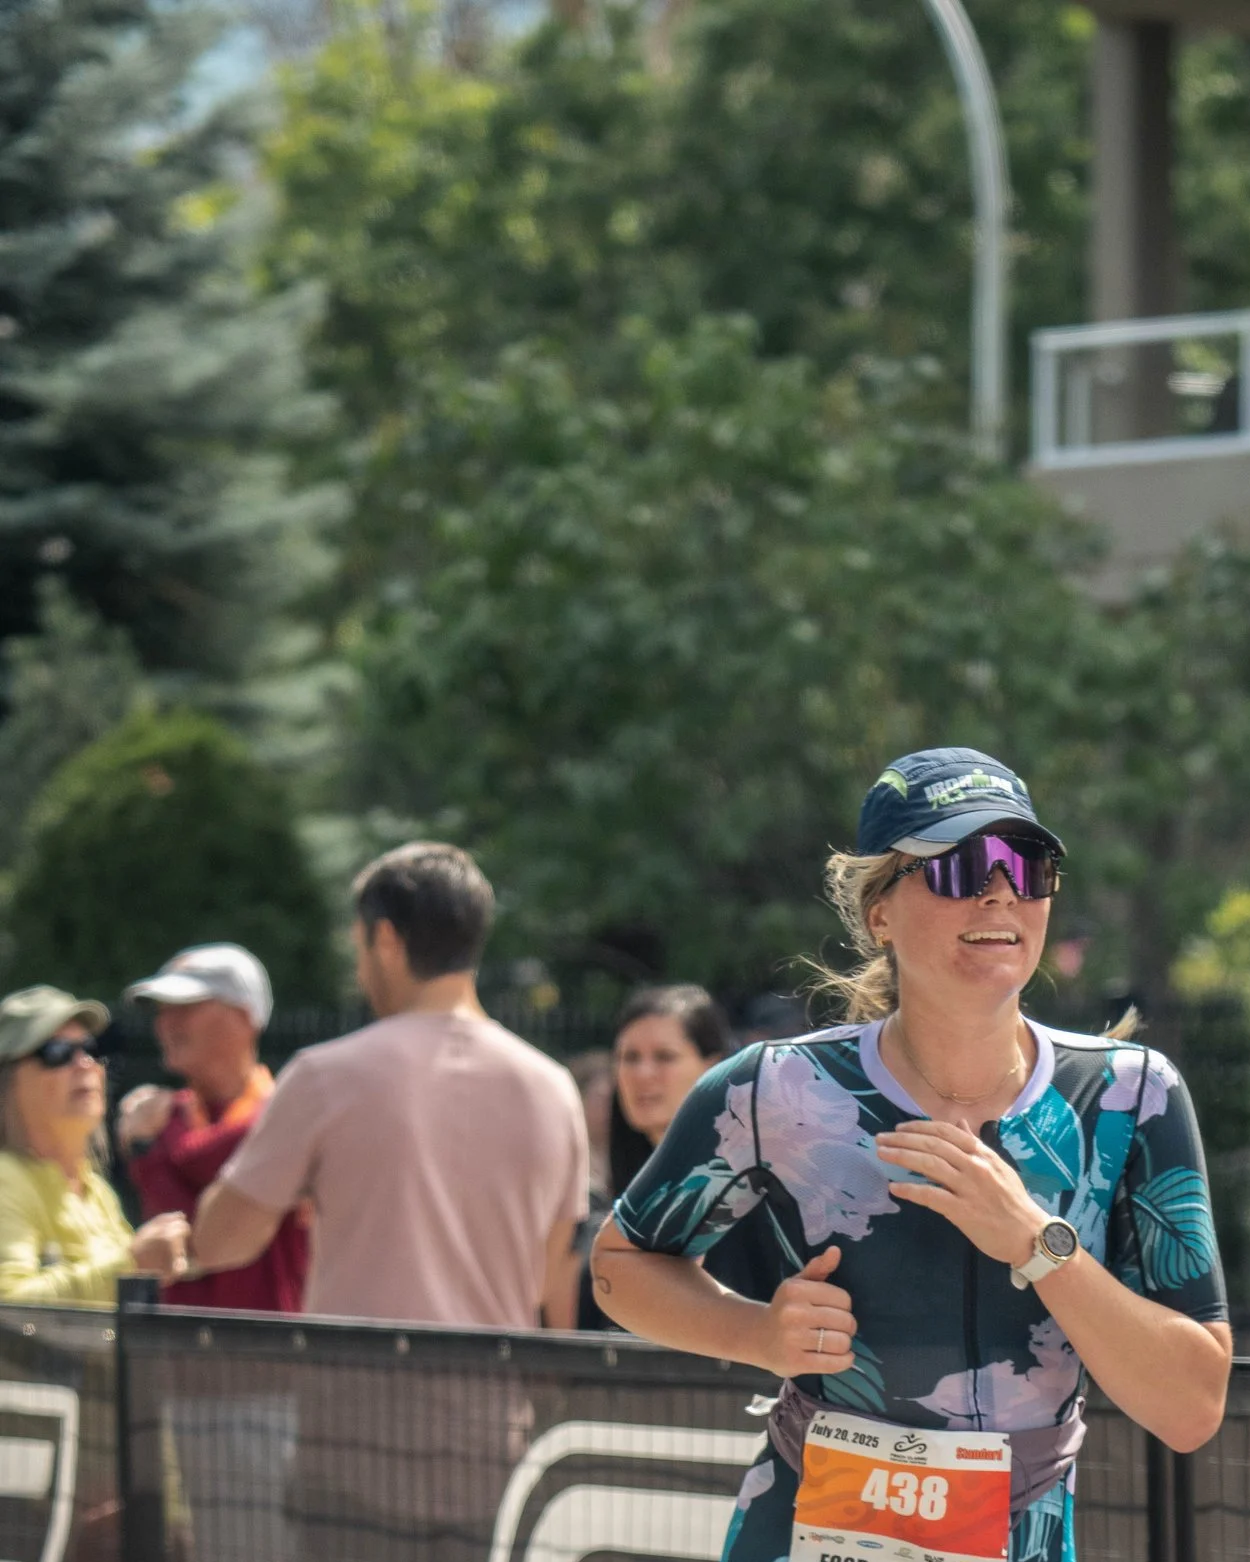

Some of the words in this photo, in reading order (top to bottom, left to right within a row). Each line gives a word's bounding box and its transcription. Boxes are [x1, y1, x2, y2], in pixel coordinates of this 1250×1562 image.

[811, 1424, 833, 1439] July
[851, 1431, 880, 1449] 2025
[955, 1446, 1003, 1461] Standard
[861, 1468, 949, 1521] 438
